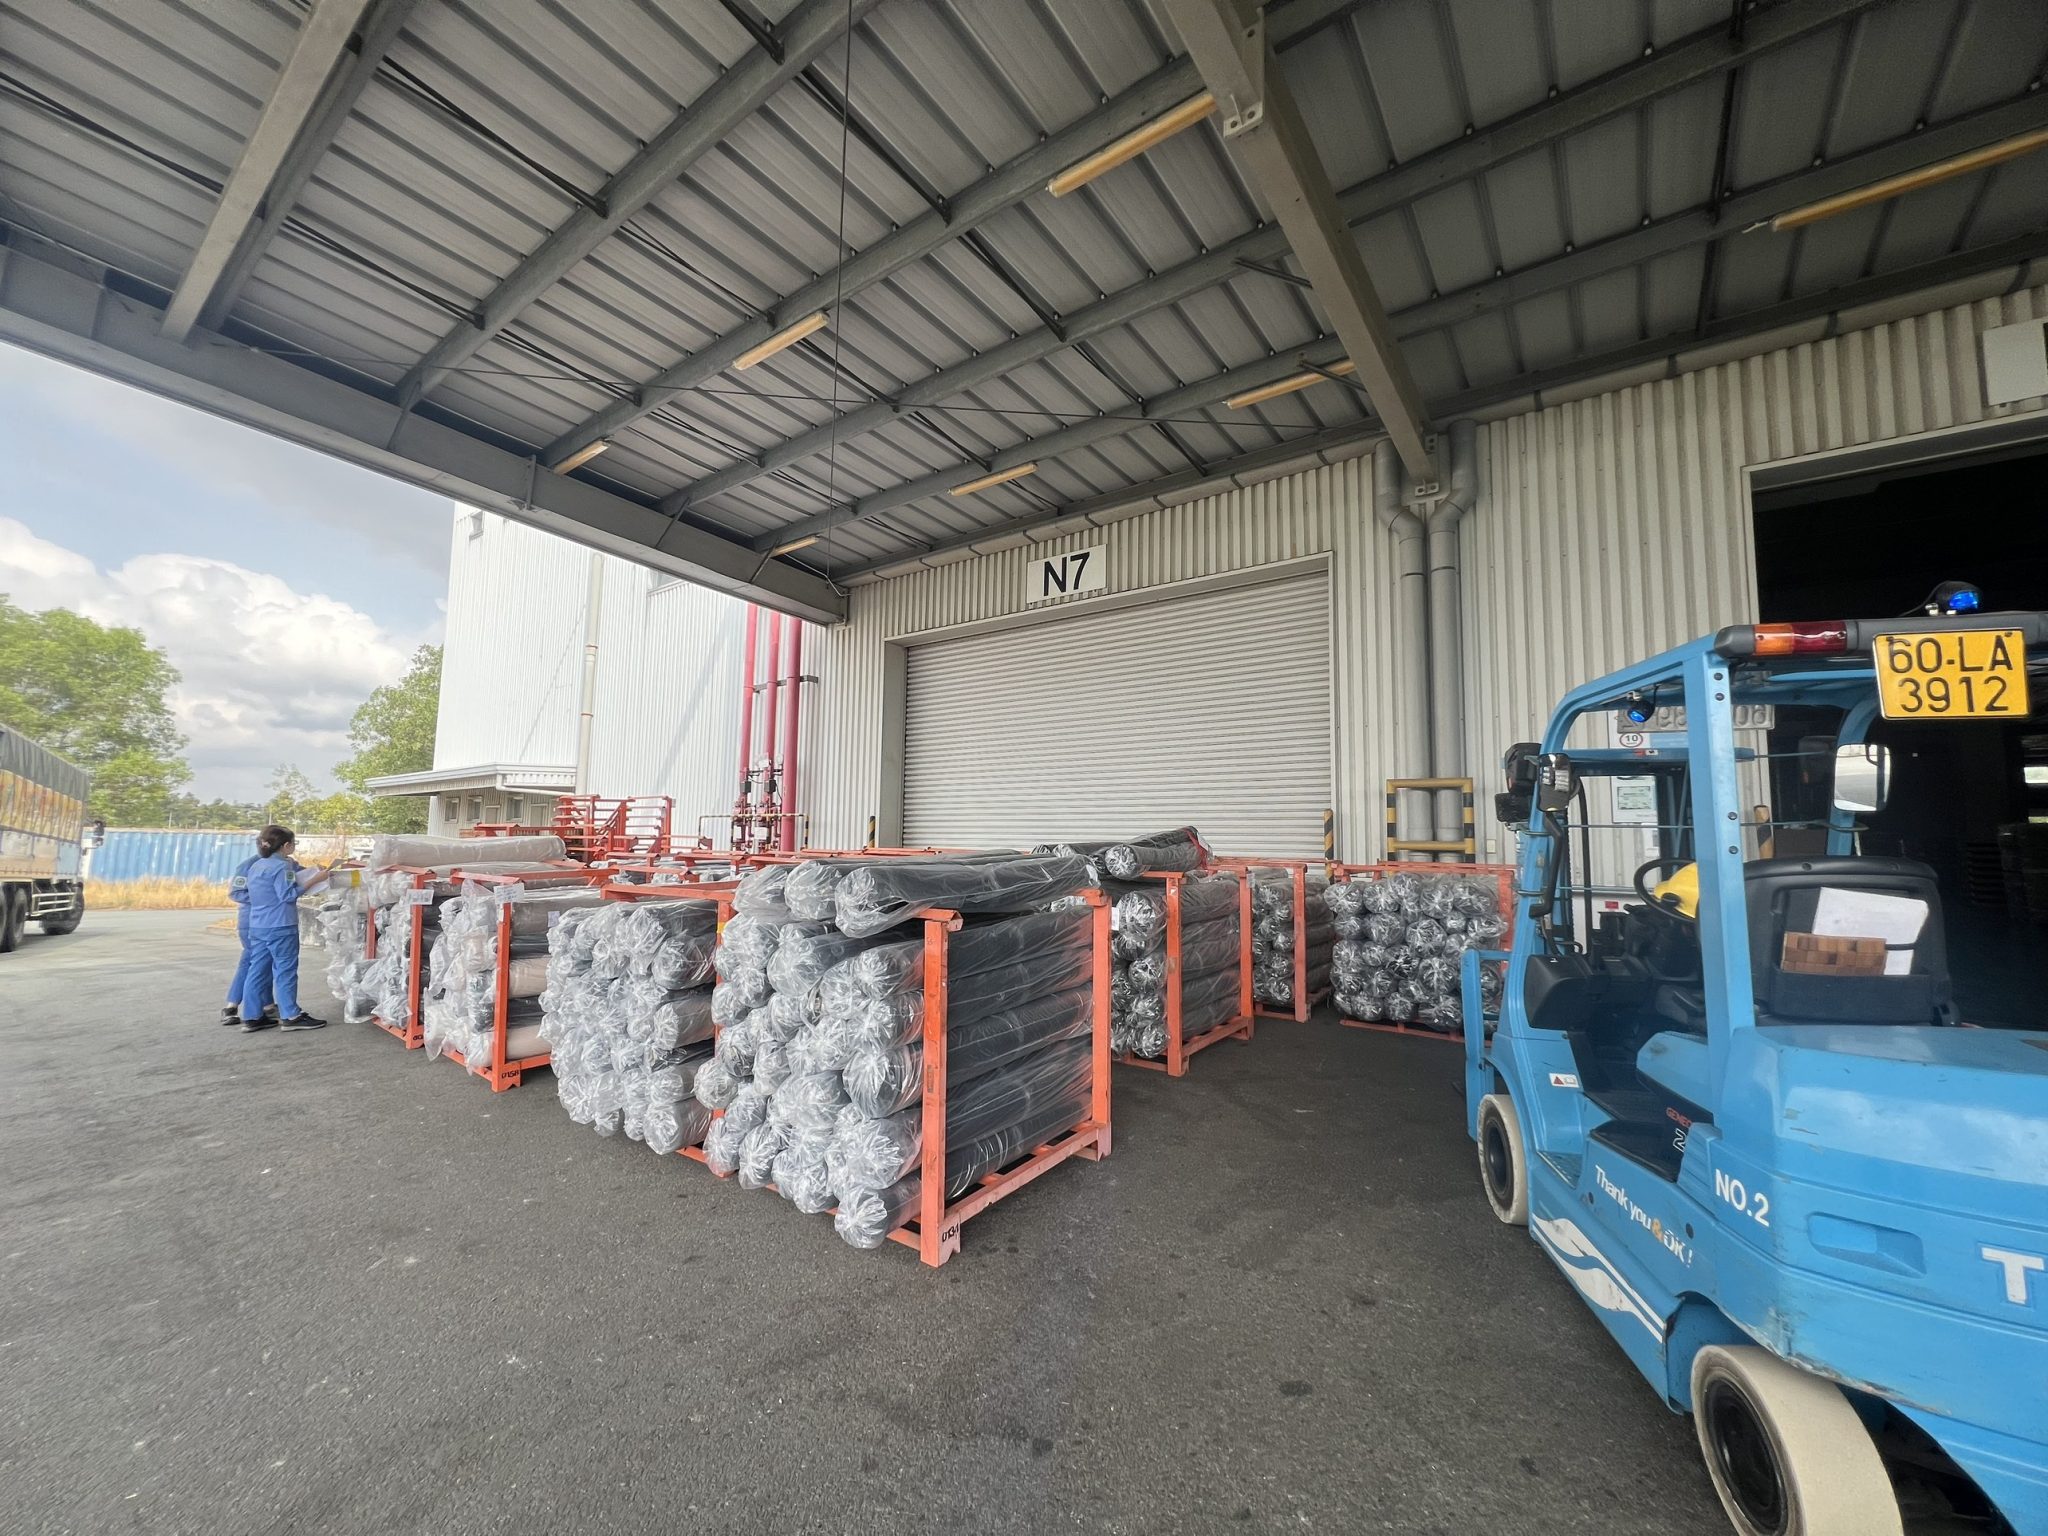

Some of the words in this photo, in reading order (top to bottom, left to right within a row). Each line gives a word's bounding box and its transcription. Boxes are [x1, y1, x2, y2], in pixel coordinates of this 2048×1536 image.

[1043, 551, 1090, 596] N7
[1887, 635, 2013, 674] 60-LA
[1898, 676, 2009, 713] 3912
[1595, 1164, 1628, 1212] Thank
[1629, 1200, 1651, 1231] you
[1715, 1168, 1770, 1228] NO.2
[1981, 1246, 2045, 1305] T
